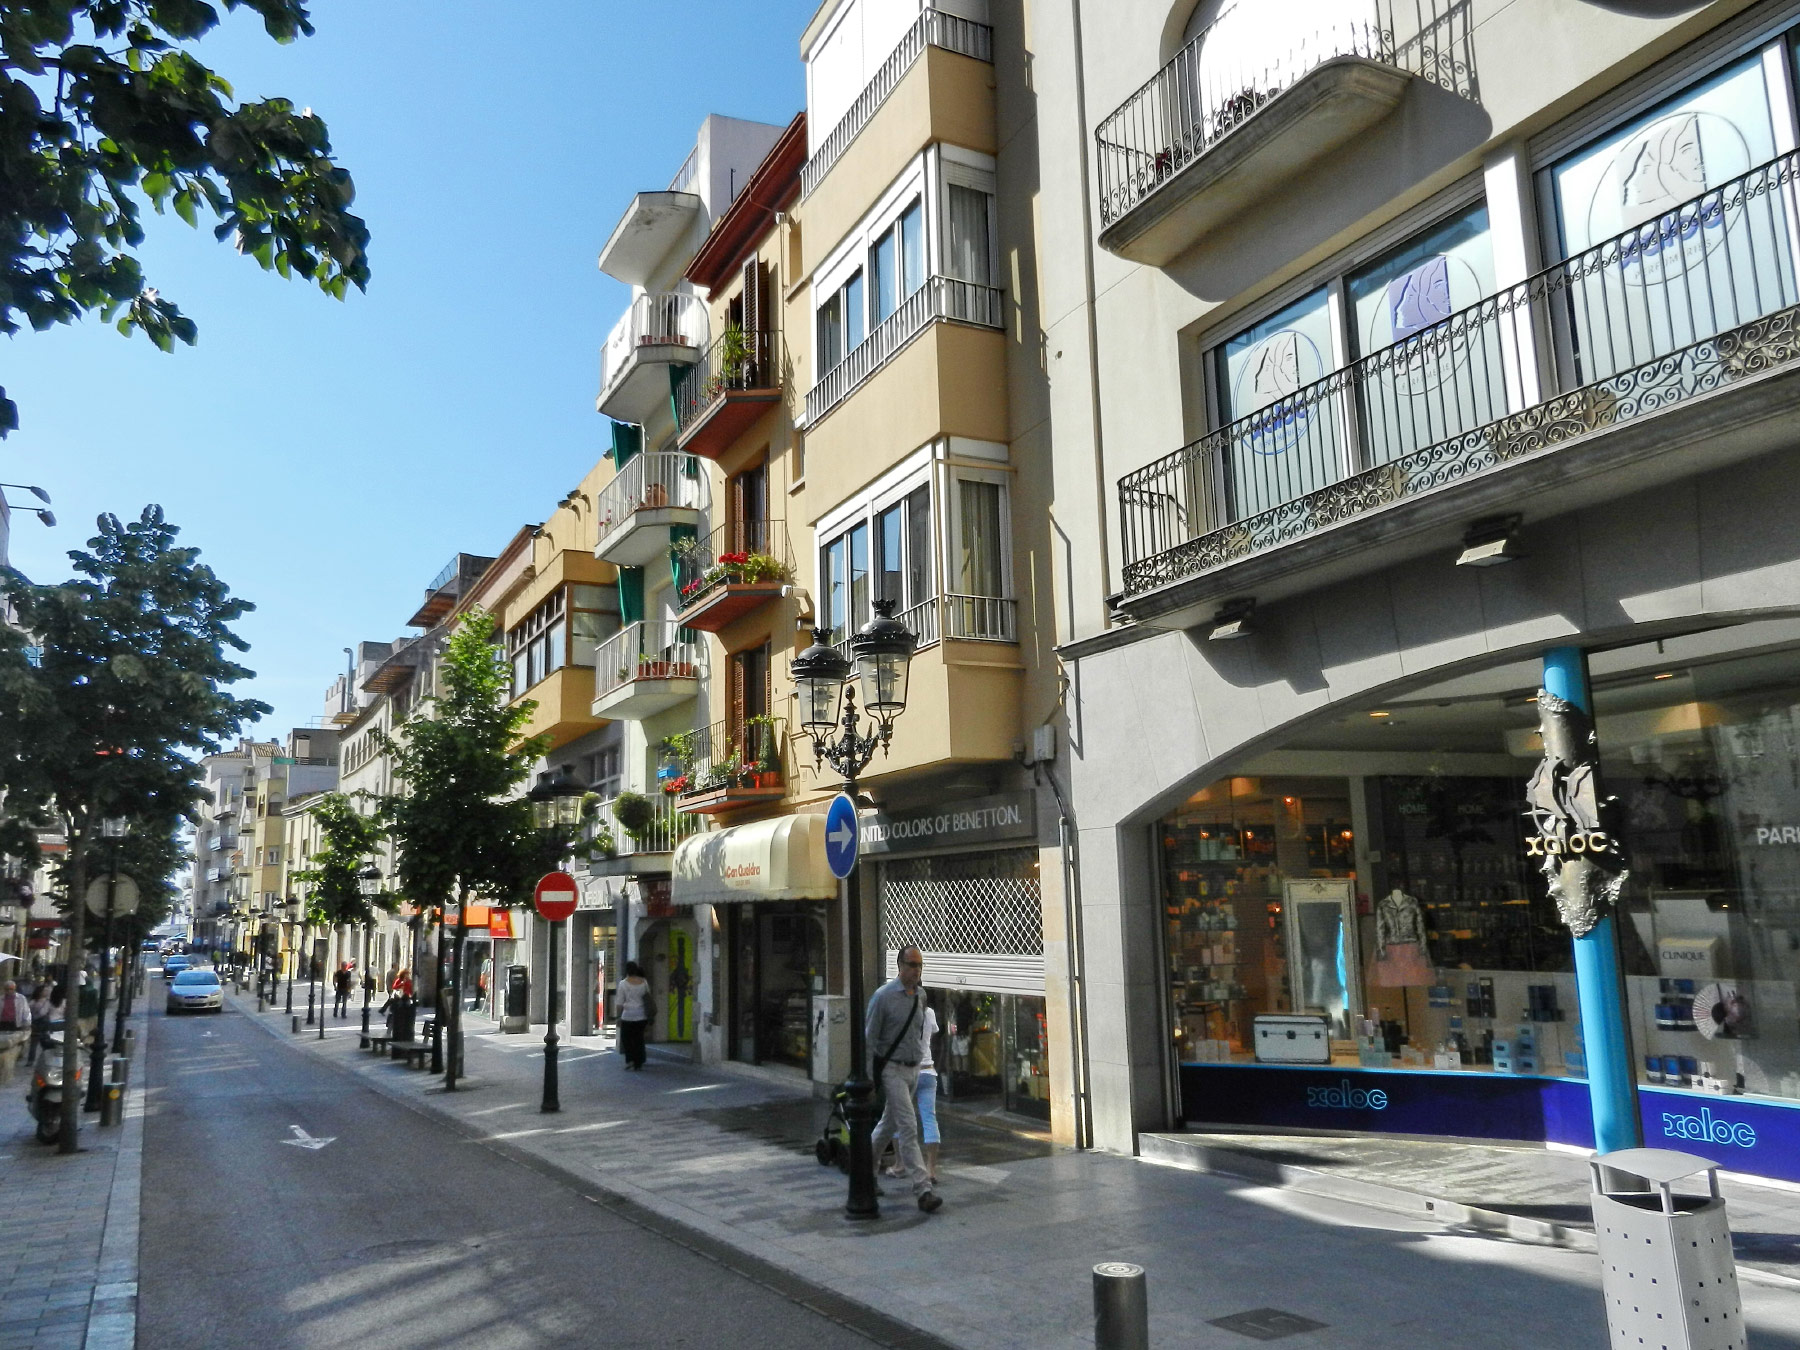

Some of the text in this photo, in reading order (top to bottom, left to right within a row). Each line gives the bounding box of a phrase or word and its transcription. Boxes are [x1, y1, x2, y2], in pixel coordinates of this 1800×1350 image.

[892, 817, 933, 839] COLORS
[935, 813, 950, 834] OF
[952, 804, 1022, 832] BENETTON.
[1399, 803, 1427, 814] HOME
[1662, 951, 1706, 961] CLINIQUE
[1307, 1079, 1387, 1110] xaloc
[1662, 1106, 1756, 1148] xaloc
